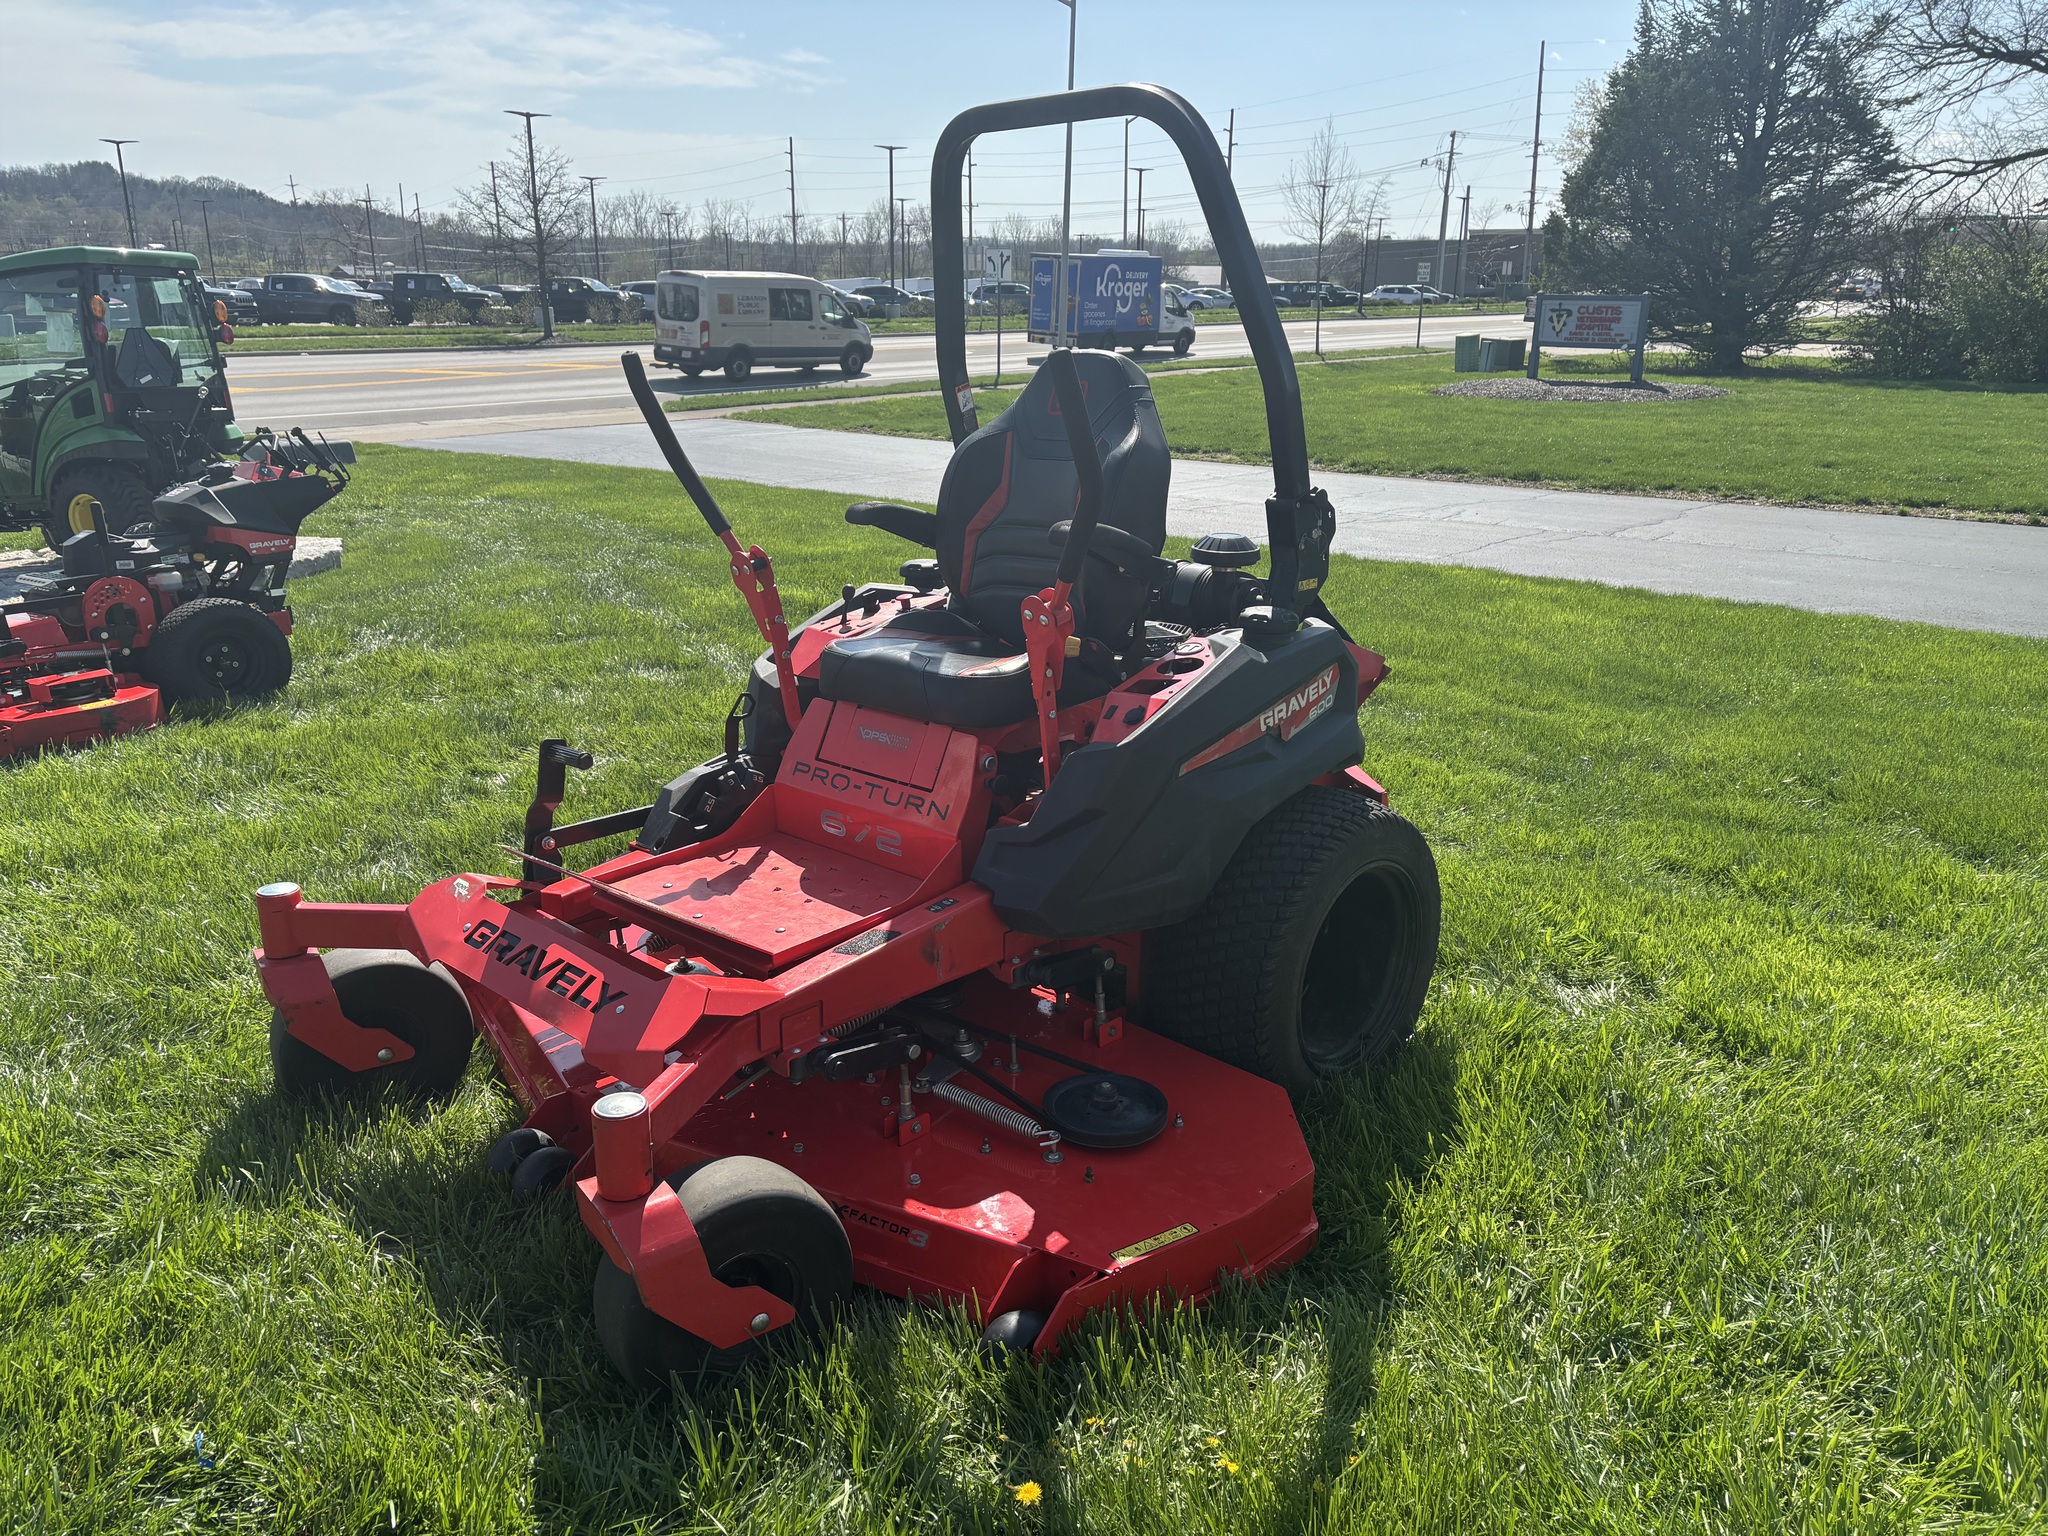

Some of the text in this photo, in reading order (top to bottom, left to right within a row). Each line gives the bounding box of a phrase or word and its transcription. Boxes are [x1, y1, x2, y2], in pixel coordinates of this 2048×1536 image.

[1096, 263, 1148, 313] Kroger
[1125, 271, 1149, 279] DELIVERY
[1578, 306, 1623, 316] CUSTIS
[249, 538, 290, 549] GRAVELY
[1259, 669, 1334, 732] GRAVELY
[1308, 694, 1334, 720] 600
[792, 761, 950, 821] PRO-TURN
[463, 919, 629, 1014] GRAVELY
